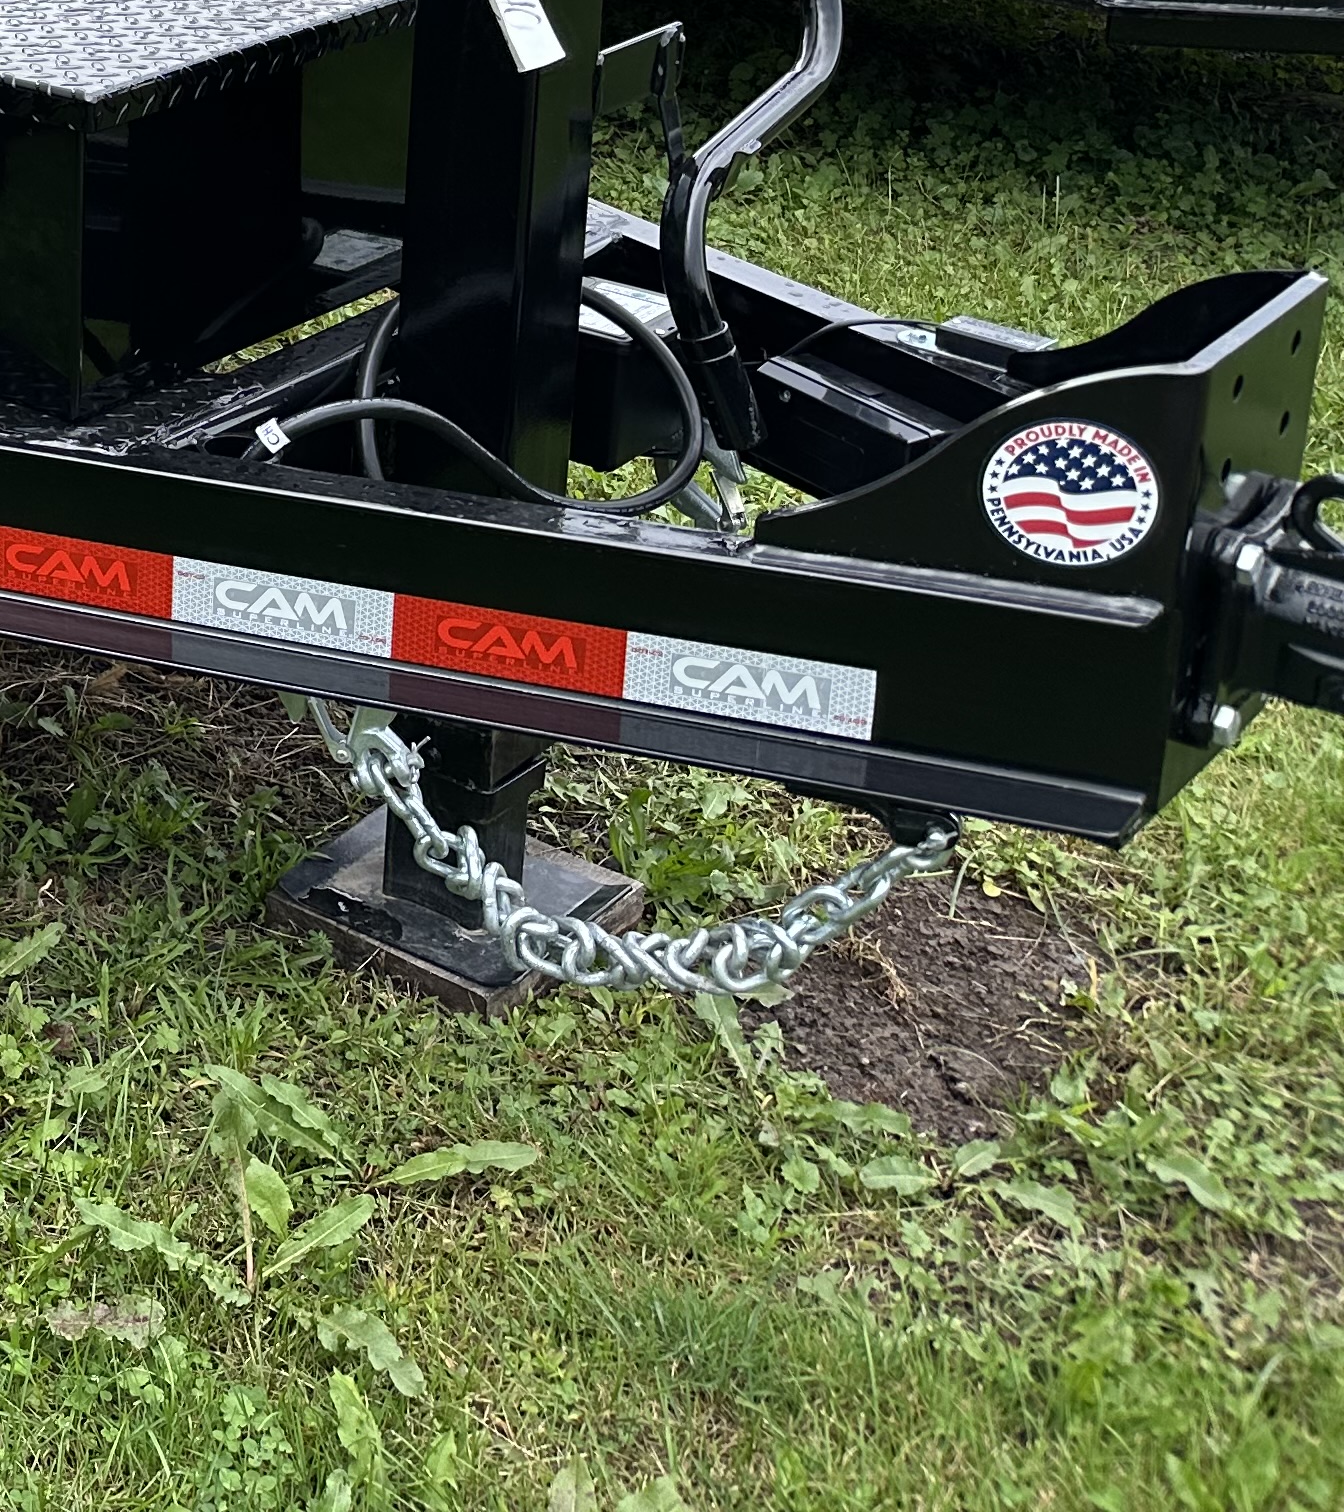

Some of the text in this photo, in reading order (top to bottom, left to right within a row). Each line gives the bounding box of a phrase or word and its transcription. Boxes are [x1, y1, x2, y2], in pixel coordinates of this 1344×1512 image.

[1004, 424, 1152, 484] PROUDLY MADE IN
[1109, 526, 1144, 552] USA
[6, 544, 130, 591] CAM
[215, 580, 347, 629] CAM
[216, 607, 349, 637] SUPERLINE
[438, 618, 577, 668] CAM
[673, 656, 821, 710] CAM
[673, 685, 823, 718] SUPERLINE
